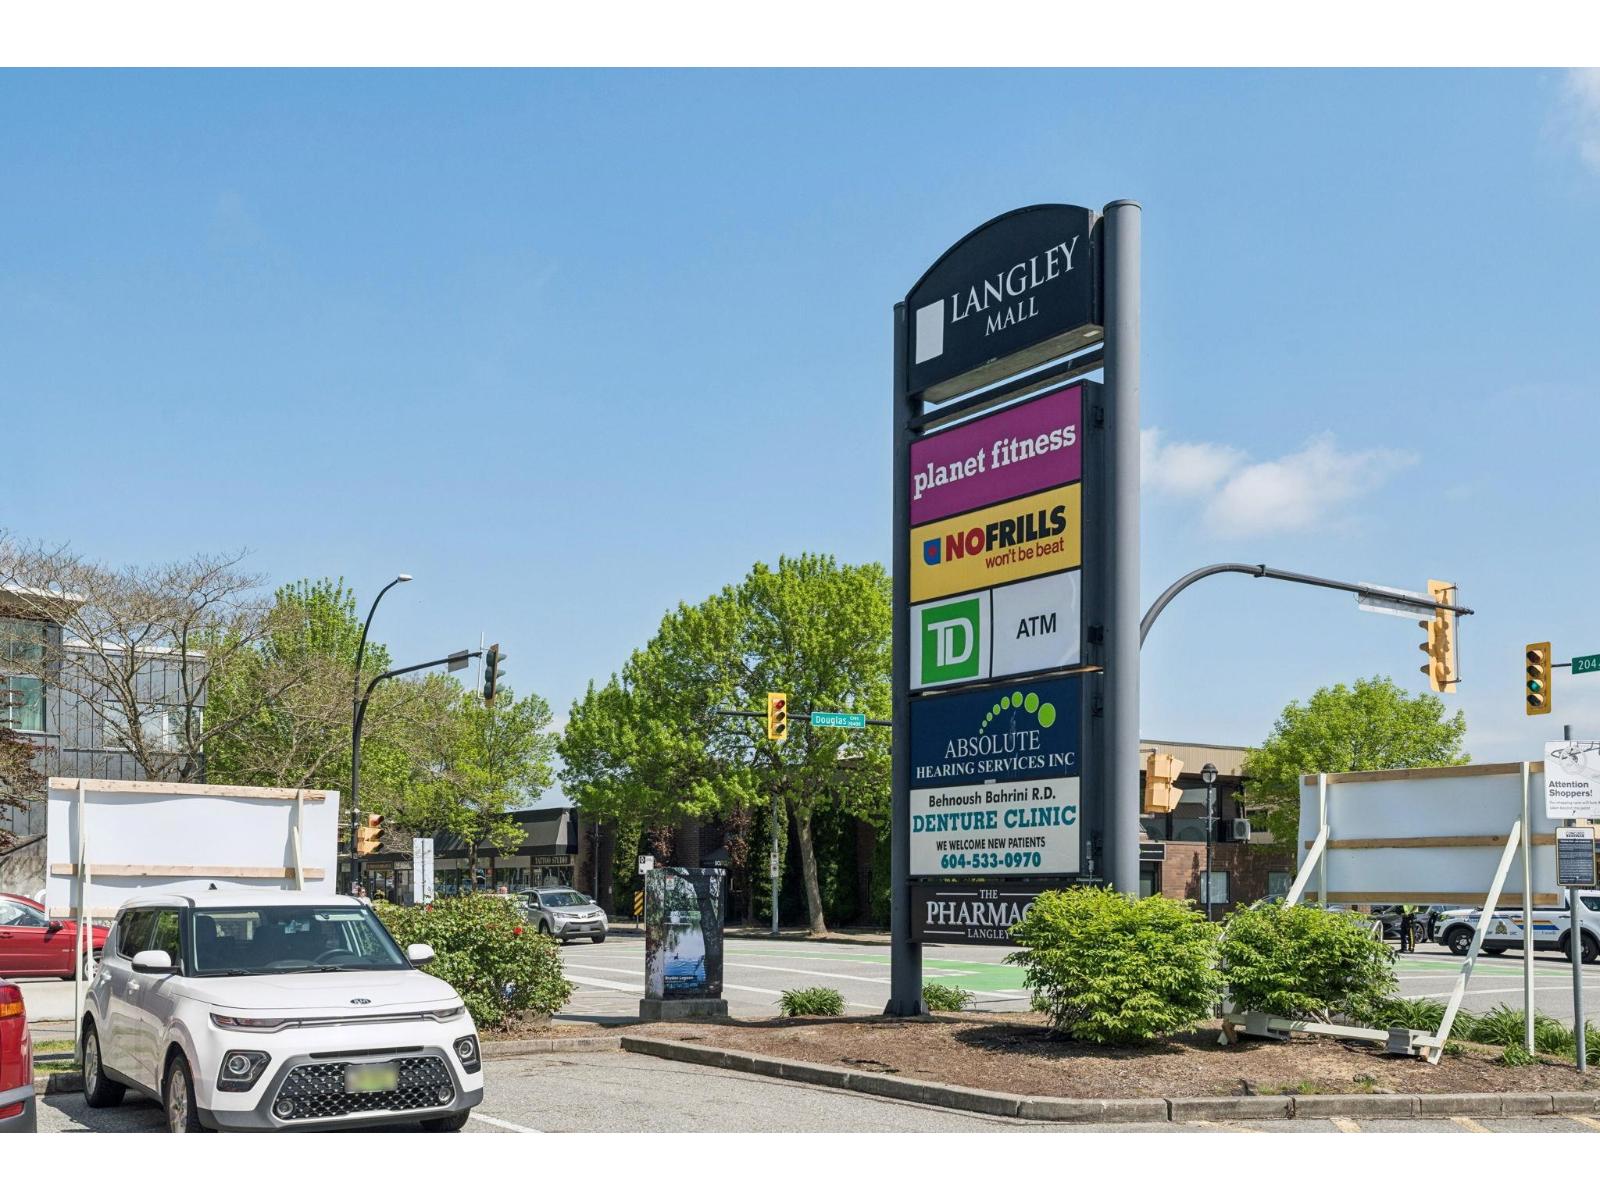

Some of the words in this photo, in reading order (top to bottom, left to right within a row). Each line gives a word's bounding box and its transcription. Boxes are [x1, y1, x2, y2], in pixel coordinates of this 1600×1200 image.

[951, 235, 1080, 323] LANGLEY
[985, 296, 1039, 336] MALL
[913, 448, 986, 500] planet
[991, 424, 1076, 470] fitness
[985, 549, 1016, 569] won't
[1018, 544, 1034, 561] be
[1036, 537, 1065, 557] beat
[1016, 612, 1057, 639] ATM
[927, 617, 974, 667] TD
[1578, 658, 1597, 671] 204
[815, 715, 847, 727] Douglas
[944, 729, 1041, 759] ABSOLUTE
[916, 761, 975, 779] HEARING
[978, 754, 1045, 774] SERVICES
[1049, 752, 1075, 767] INC
[1549, 780, 1589, 788] Attention
[1549, 789, 1593, 799] Shoppers!
[929, 791, 982, 808] Behnoush
[986, 788, 1028, 804] Bahrini
[1032, 786, 1056, 801] R.D.
[912, 810, 998, 833] DENTURE
[1004, 805, 1077, 829] CLINIC
[936, 840, 948, 851] WE
[949, 839, 986, 850] WELCOME
[988, 838, 1007, 849] NEW
[1008, 836, 1046, 848] PATIENTS
[941, 851, 1042, 869] 604-533-0970
[980, 889, 999, 899] THE
[926, 901, 1036, 926] PHARMAC
[967, 928, 1010, 940] LANGLEY
